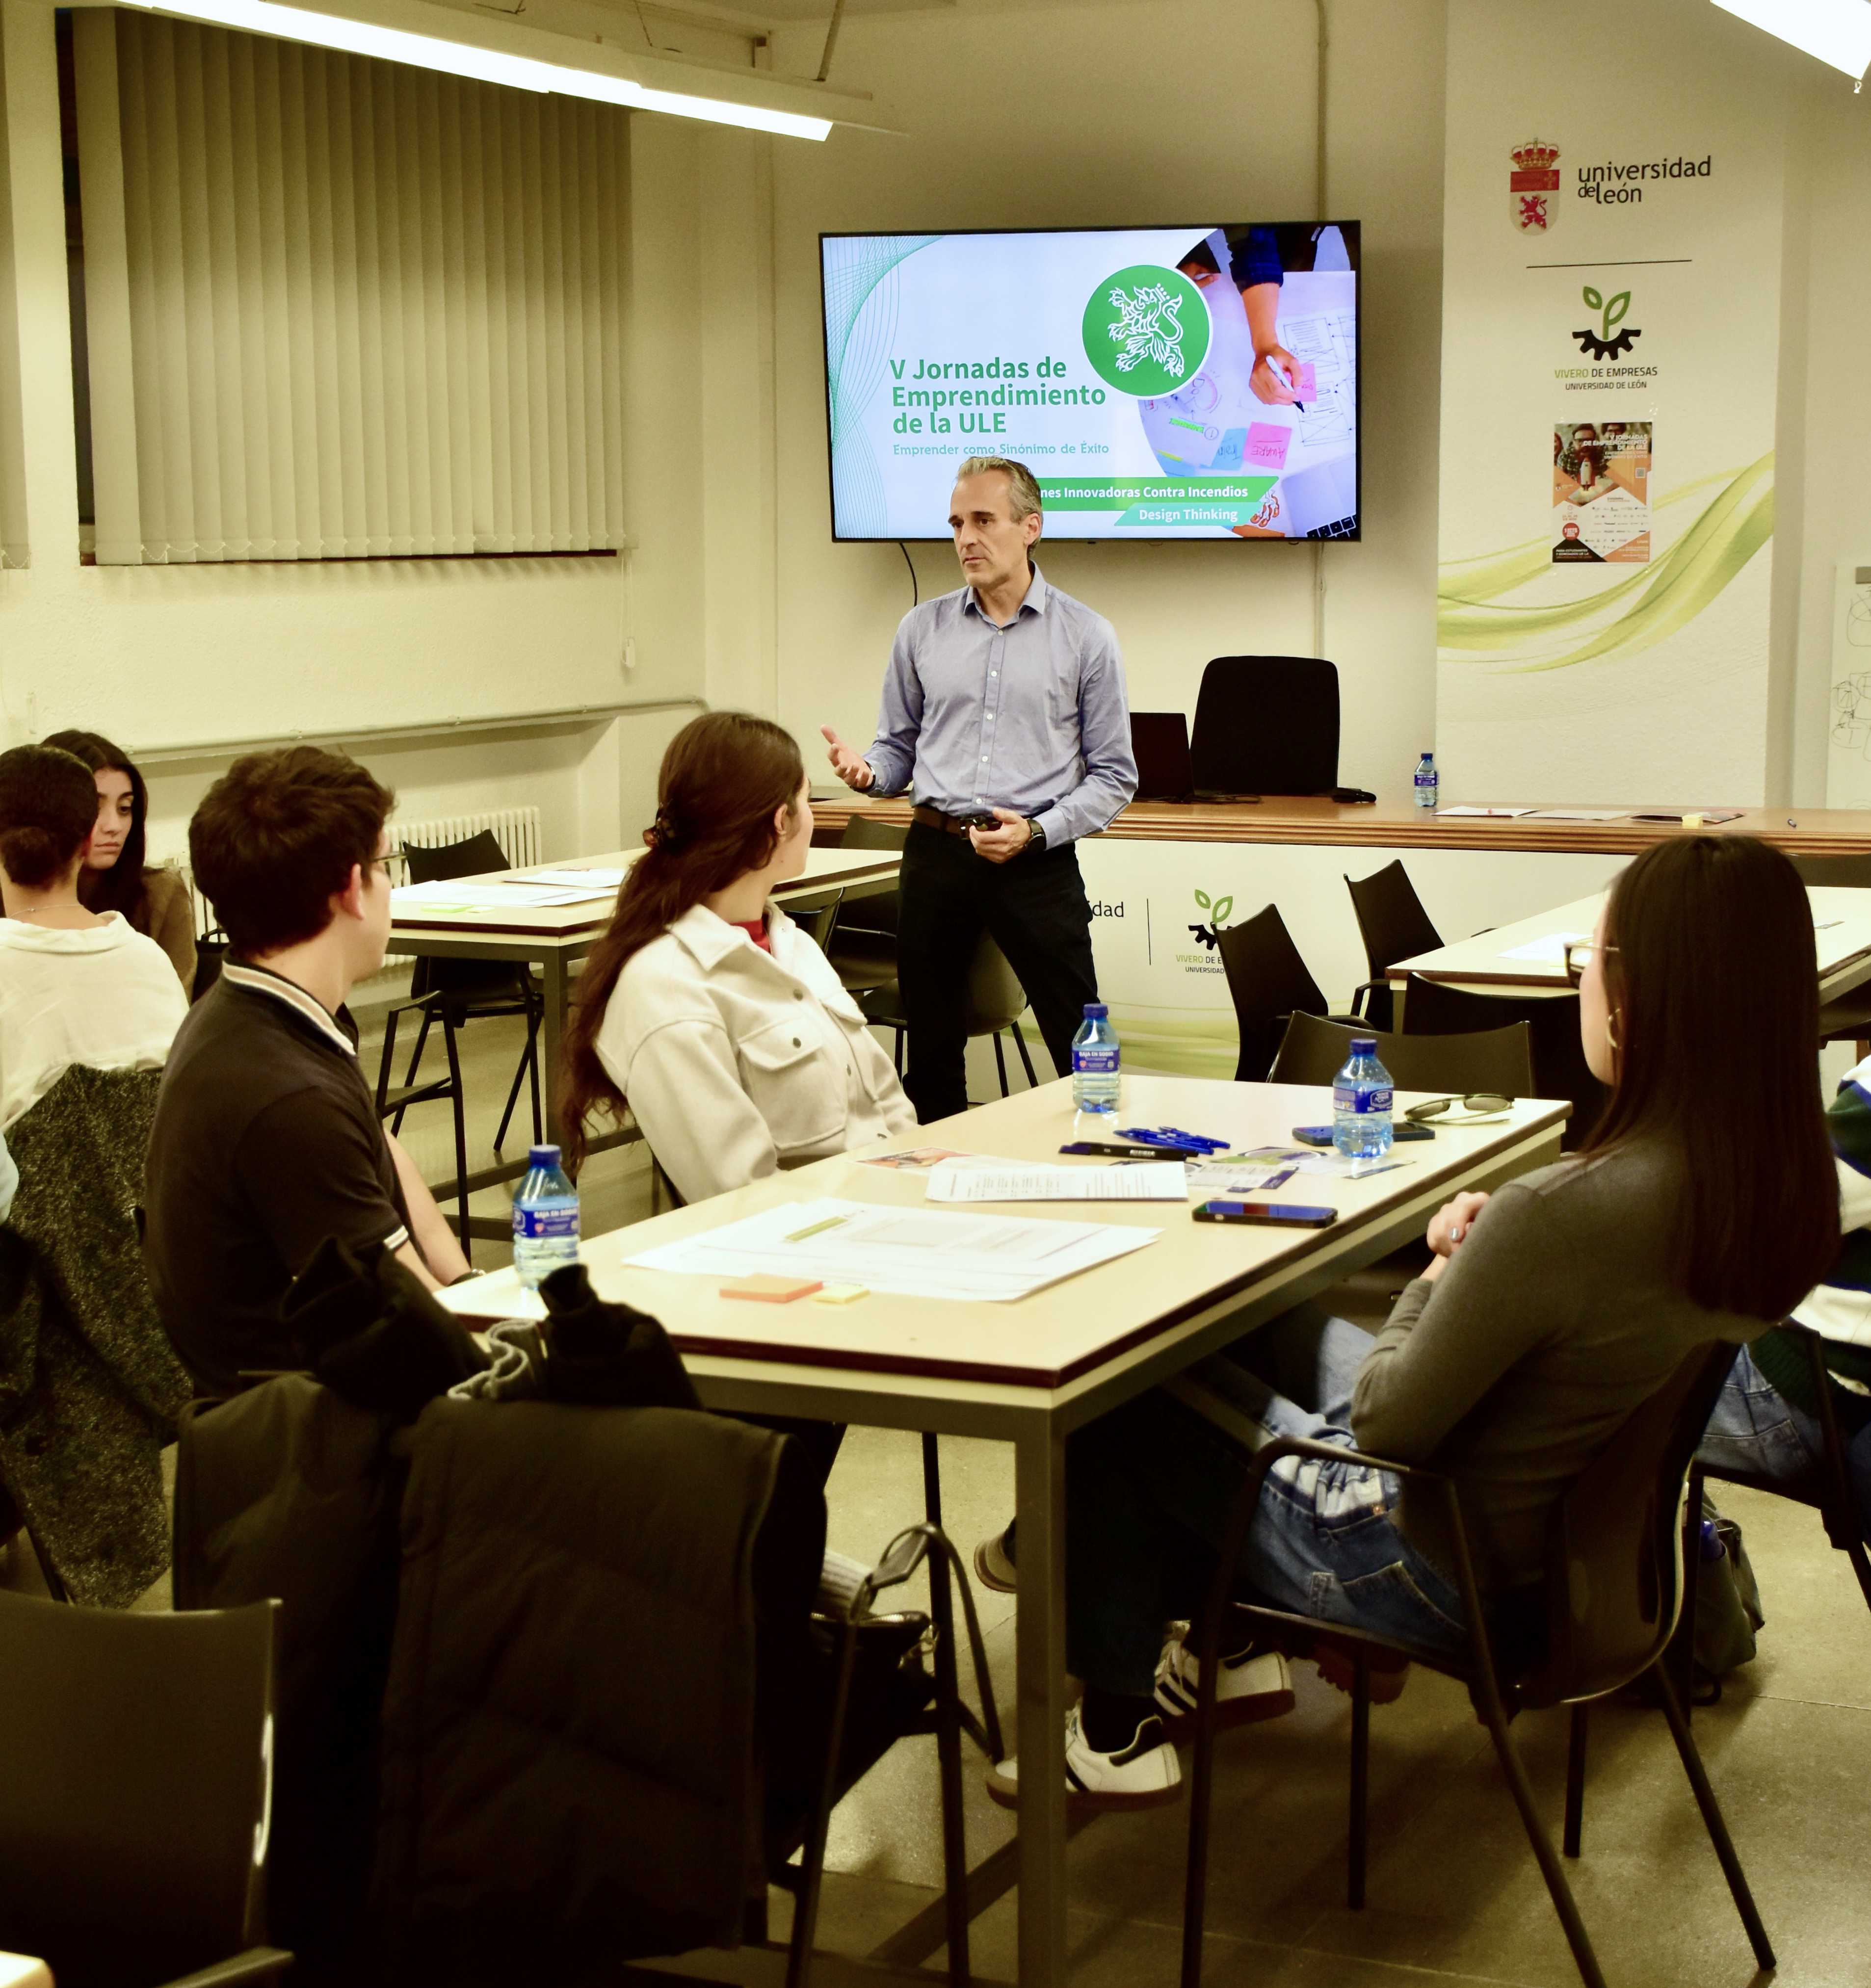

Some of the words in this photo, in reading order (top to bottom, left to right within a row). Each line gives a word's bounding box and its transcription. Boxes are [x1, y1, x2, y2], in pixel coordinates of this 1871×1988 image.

[1578, 156, 1711, 183] universidad
[1595, 182, 1642, 204] león
[890, 360, 906, 380] V
[912, 357, 1029, 380] Jornadas
[1036, 356, 1067, 378] de
[1555, 368, 1589, 378] VIVERO
[1591, 368, 1604, 378] DE
[1607, 366, 1658, 377] EMPRESAS
[1565, 381, 1614, 391] UNIVERSIDAD
[1628, 379, 1647, 389] LEÓN
[893, 383, 1106, 411] Emprendimiento
[893, 412, 922, 434] de
[930, 412, 951, 434] la
[959, 413, 1007, 433] ULE
[893, 444, 959, 457] Emprender
[963, 445, 996, 454] como
[1000, 443, 1056, 454] Sinónimo
[1060, 443, 1076, 454] de
[1080, 440, 1109, 454] Éxito
[1064, 487, 1140, 498] Innovadoras
[1143, 486, 1186, 497] Contra
[1188, 485, 1248, 497] Incendios
[1139, 509, 1181, 523] Design
[1184, 509, 1238, 523] Thinking
[1176, 955, 1204, 963] VIVERO
